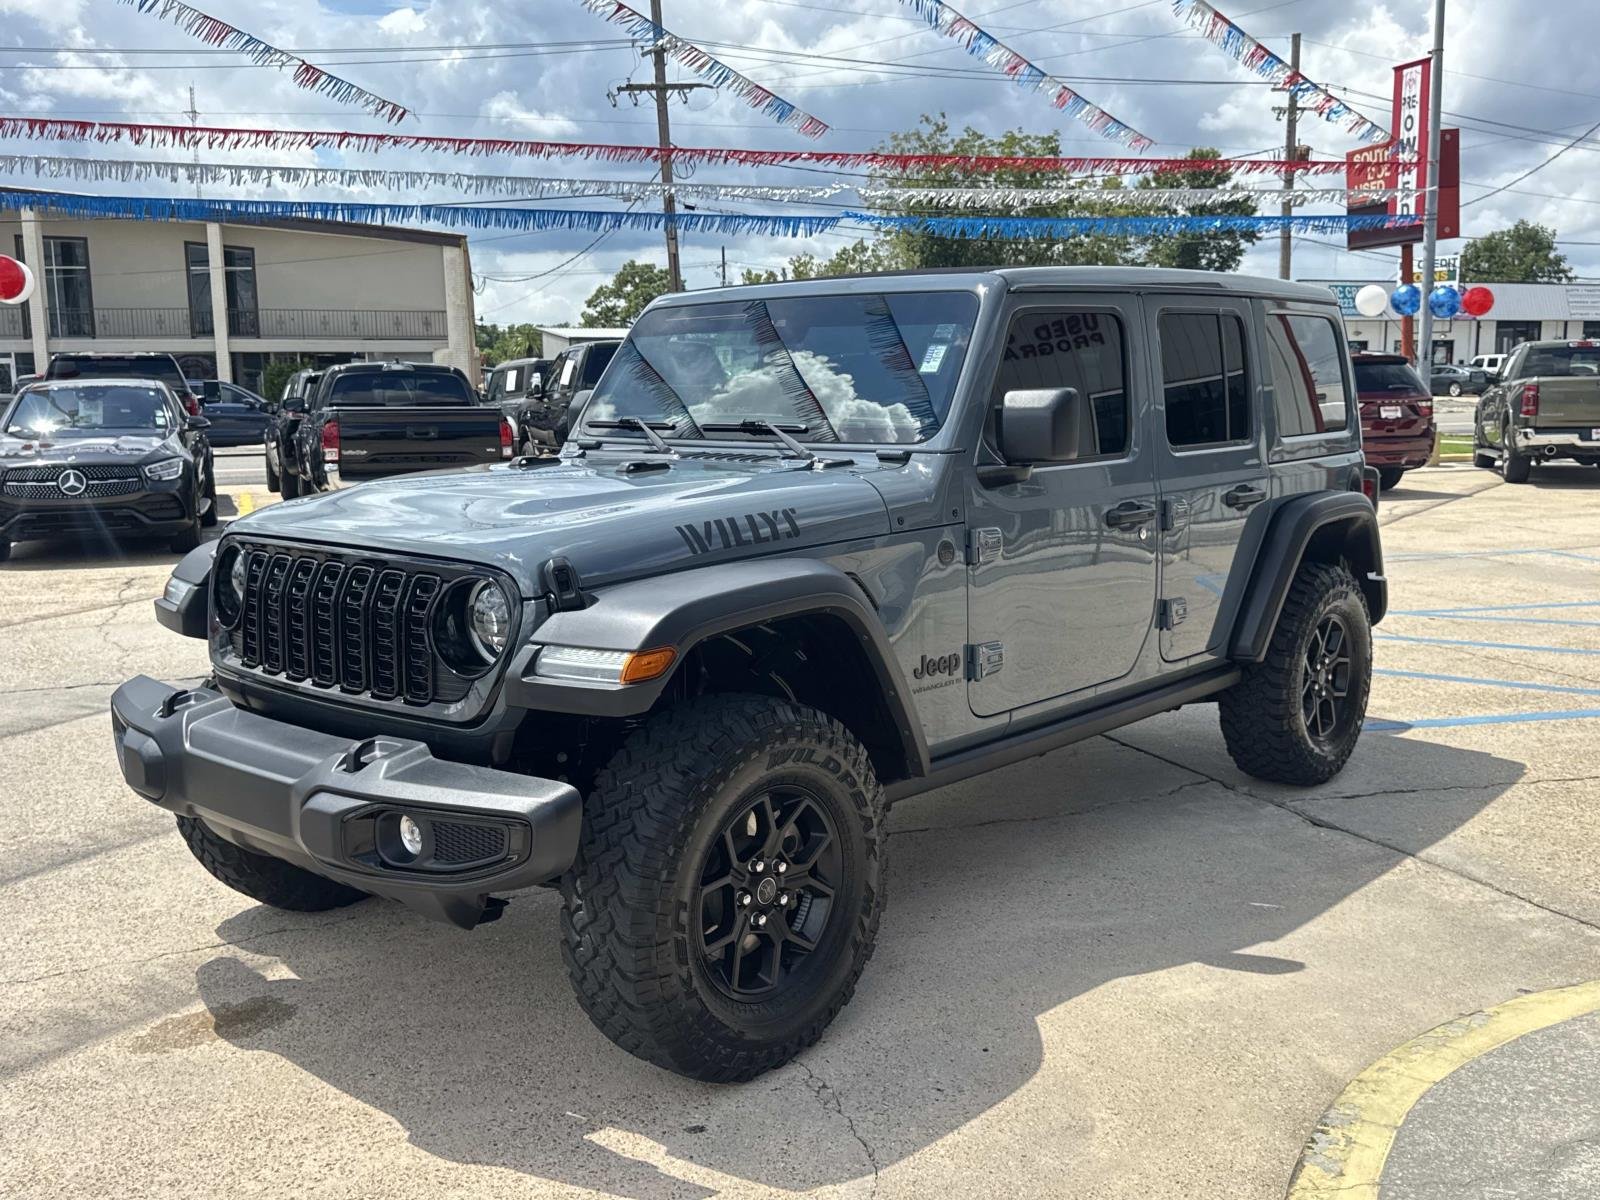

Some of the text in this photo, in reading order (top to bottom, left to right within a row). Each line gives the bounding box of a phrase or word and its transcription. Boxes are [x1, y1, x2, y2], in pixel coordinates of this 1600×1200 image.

[1418, 257, 1458, 270] CEDIT
[675, 507, 801, 555] WILLYS
[913, 653, 961, 680] Jeep
